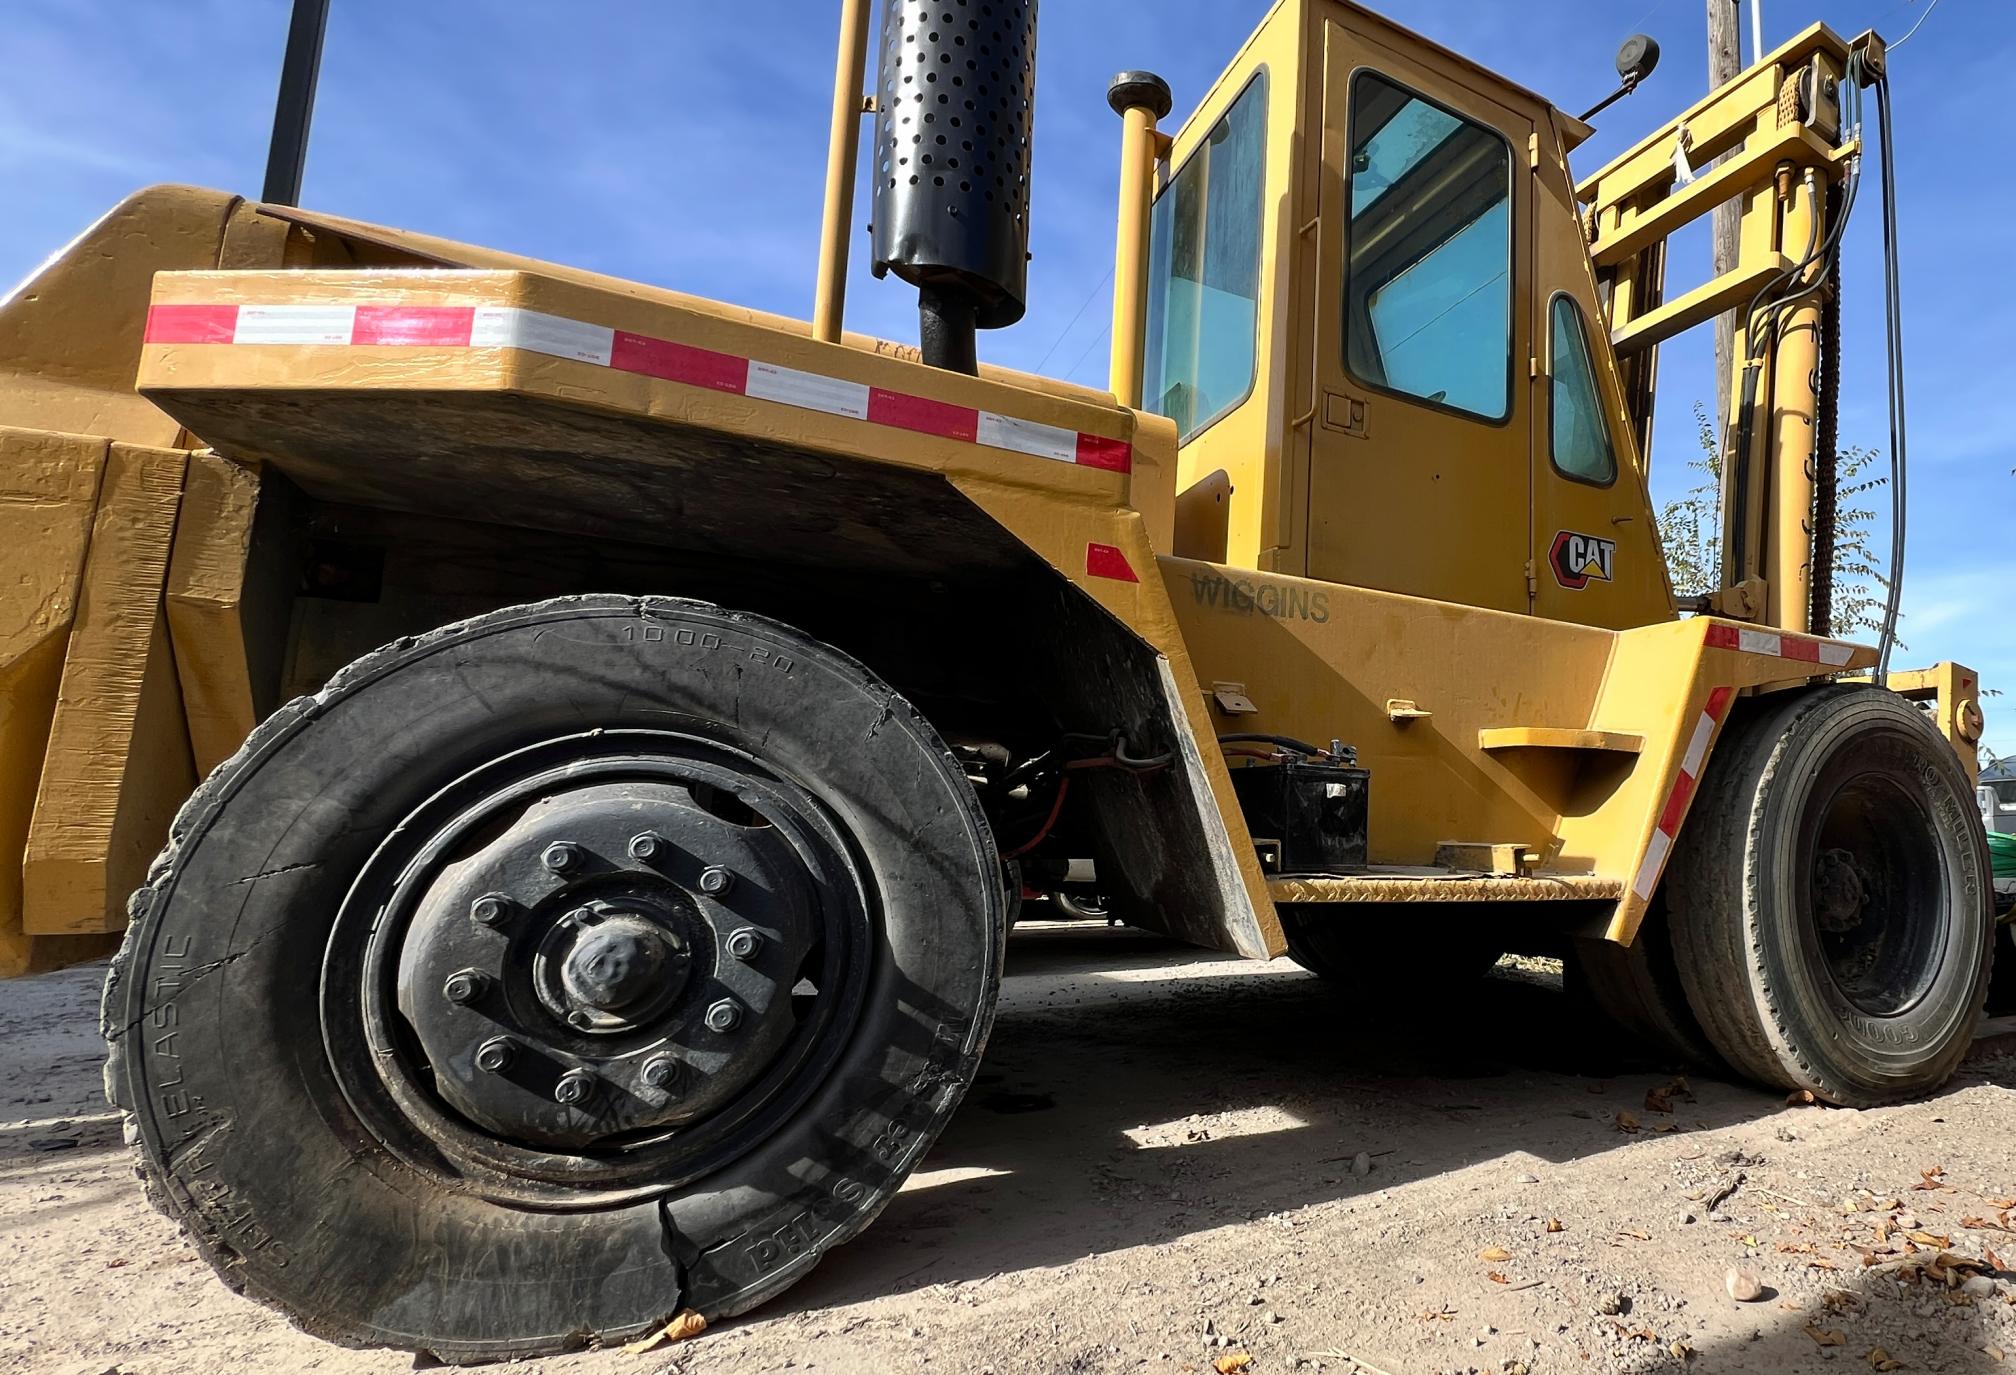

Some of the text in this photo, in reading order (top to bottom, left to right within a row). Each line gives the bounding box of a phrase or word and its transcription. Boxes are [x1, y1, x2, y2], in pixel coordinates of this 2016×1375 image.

[1568, 534, 1616, 581] CAT
[1190, 574, 1330, 624] WIGGINS
[152, 935, 191, 1119] ELASTIC
